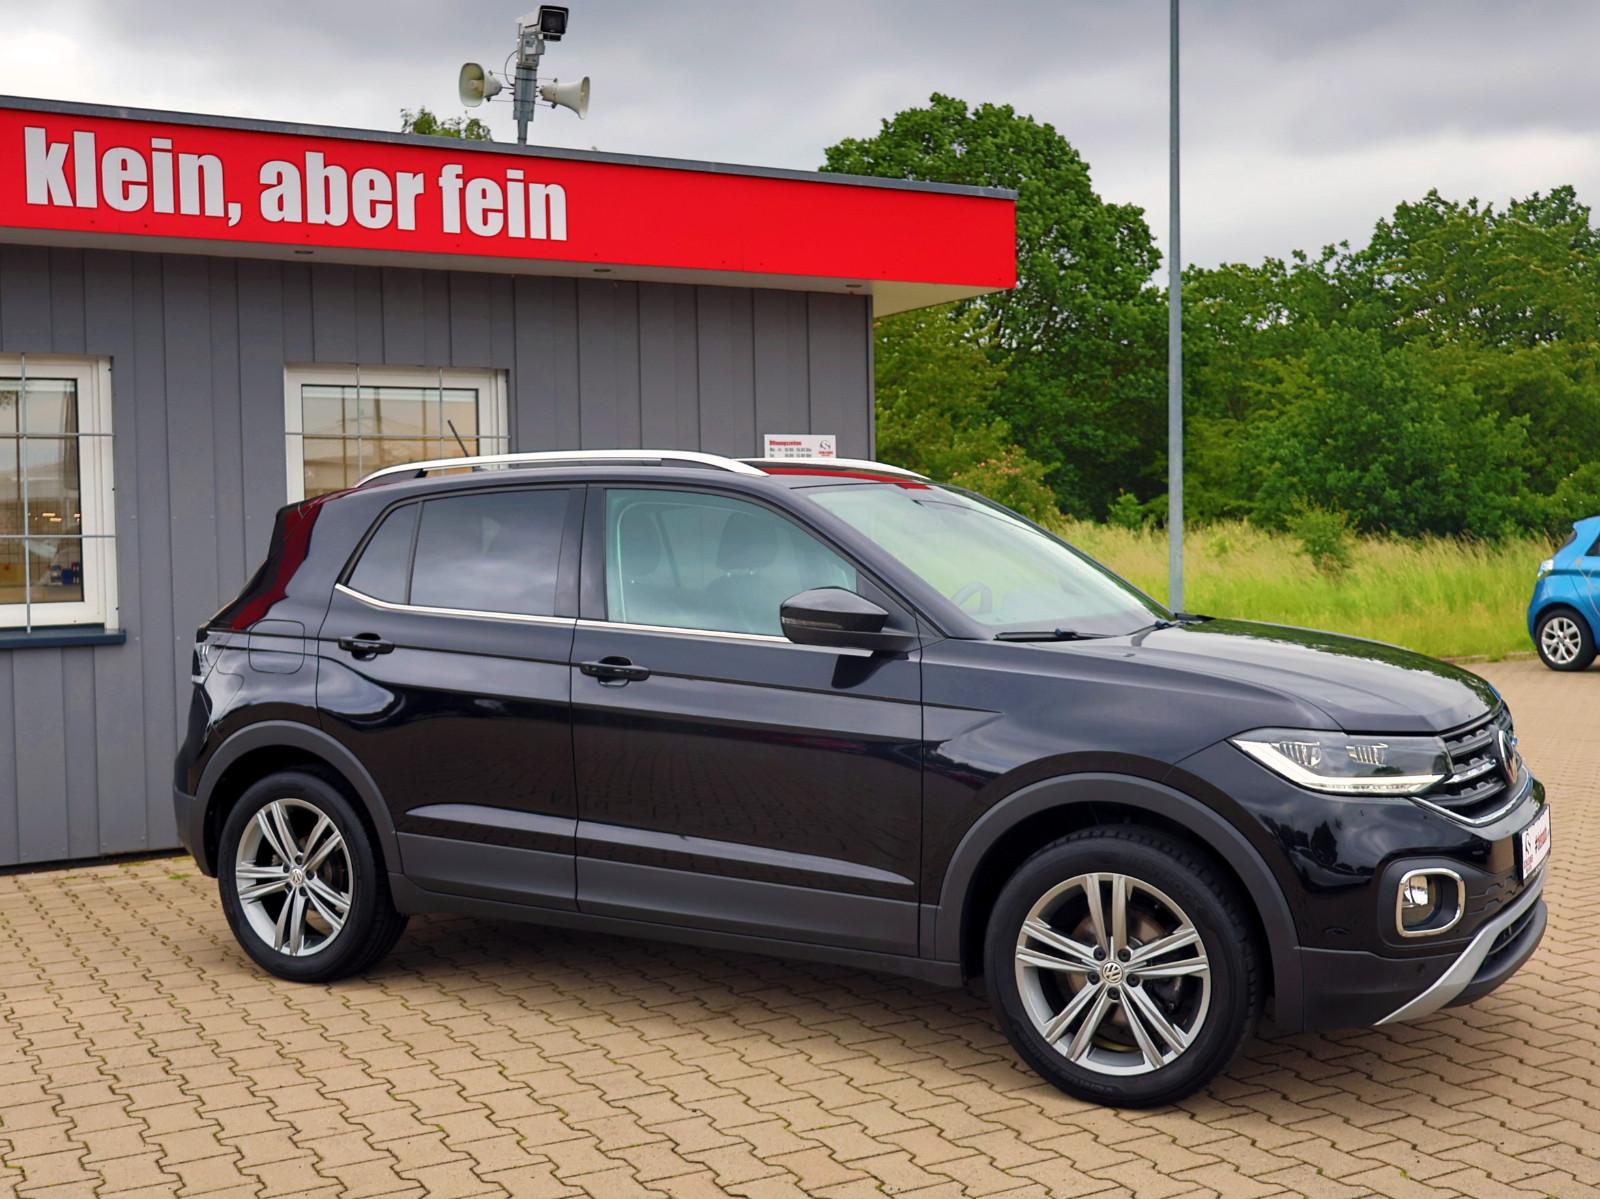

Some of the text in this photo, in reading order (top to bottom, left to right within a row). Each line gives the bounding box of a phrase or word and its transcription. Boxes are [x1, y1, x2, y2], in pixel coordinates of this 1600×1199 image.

[24, 127, 567, 241] klein, aber fein
